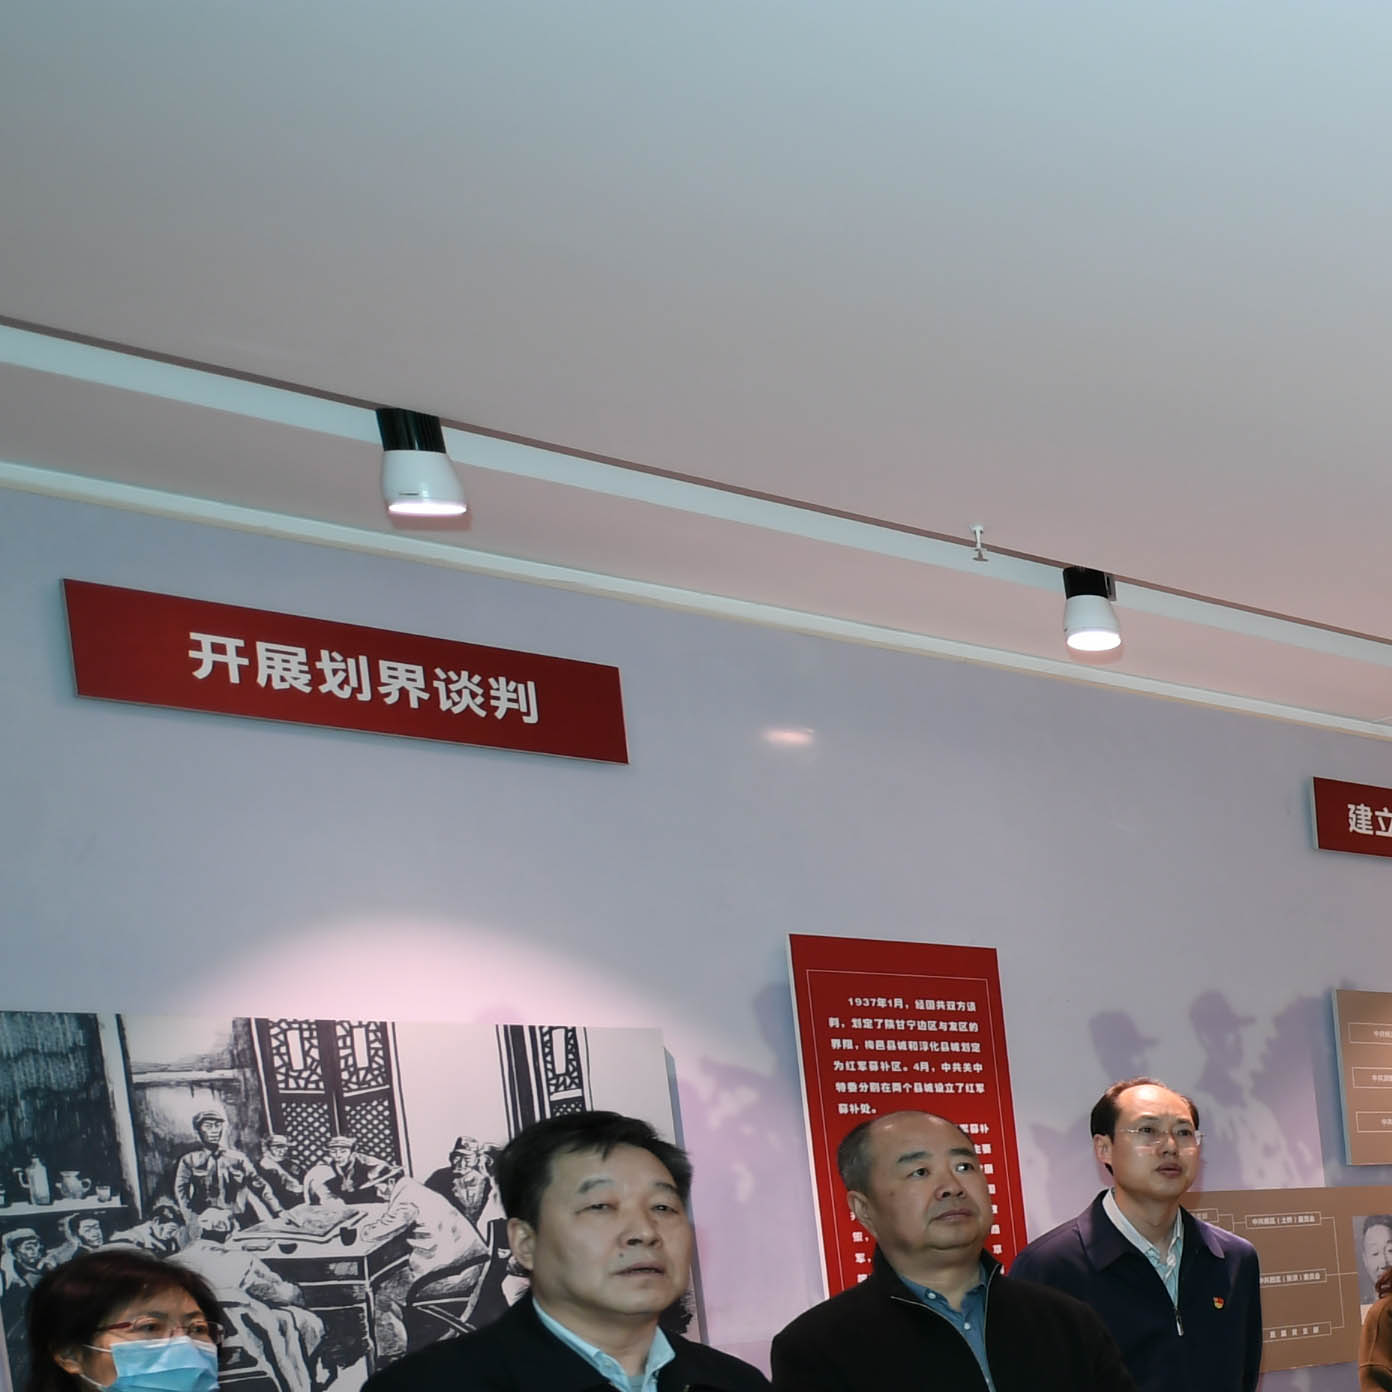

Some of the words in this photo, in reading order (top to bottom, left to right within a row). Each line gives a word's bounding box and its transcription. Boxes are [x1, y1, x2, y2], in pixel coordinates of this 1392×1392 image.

[188, 631, 541, 725] 开展划界谈判
